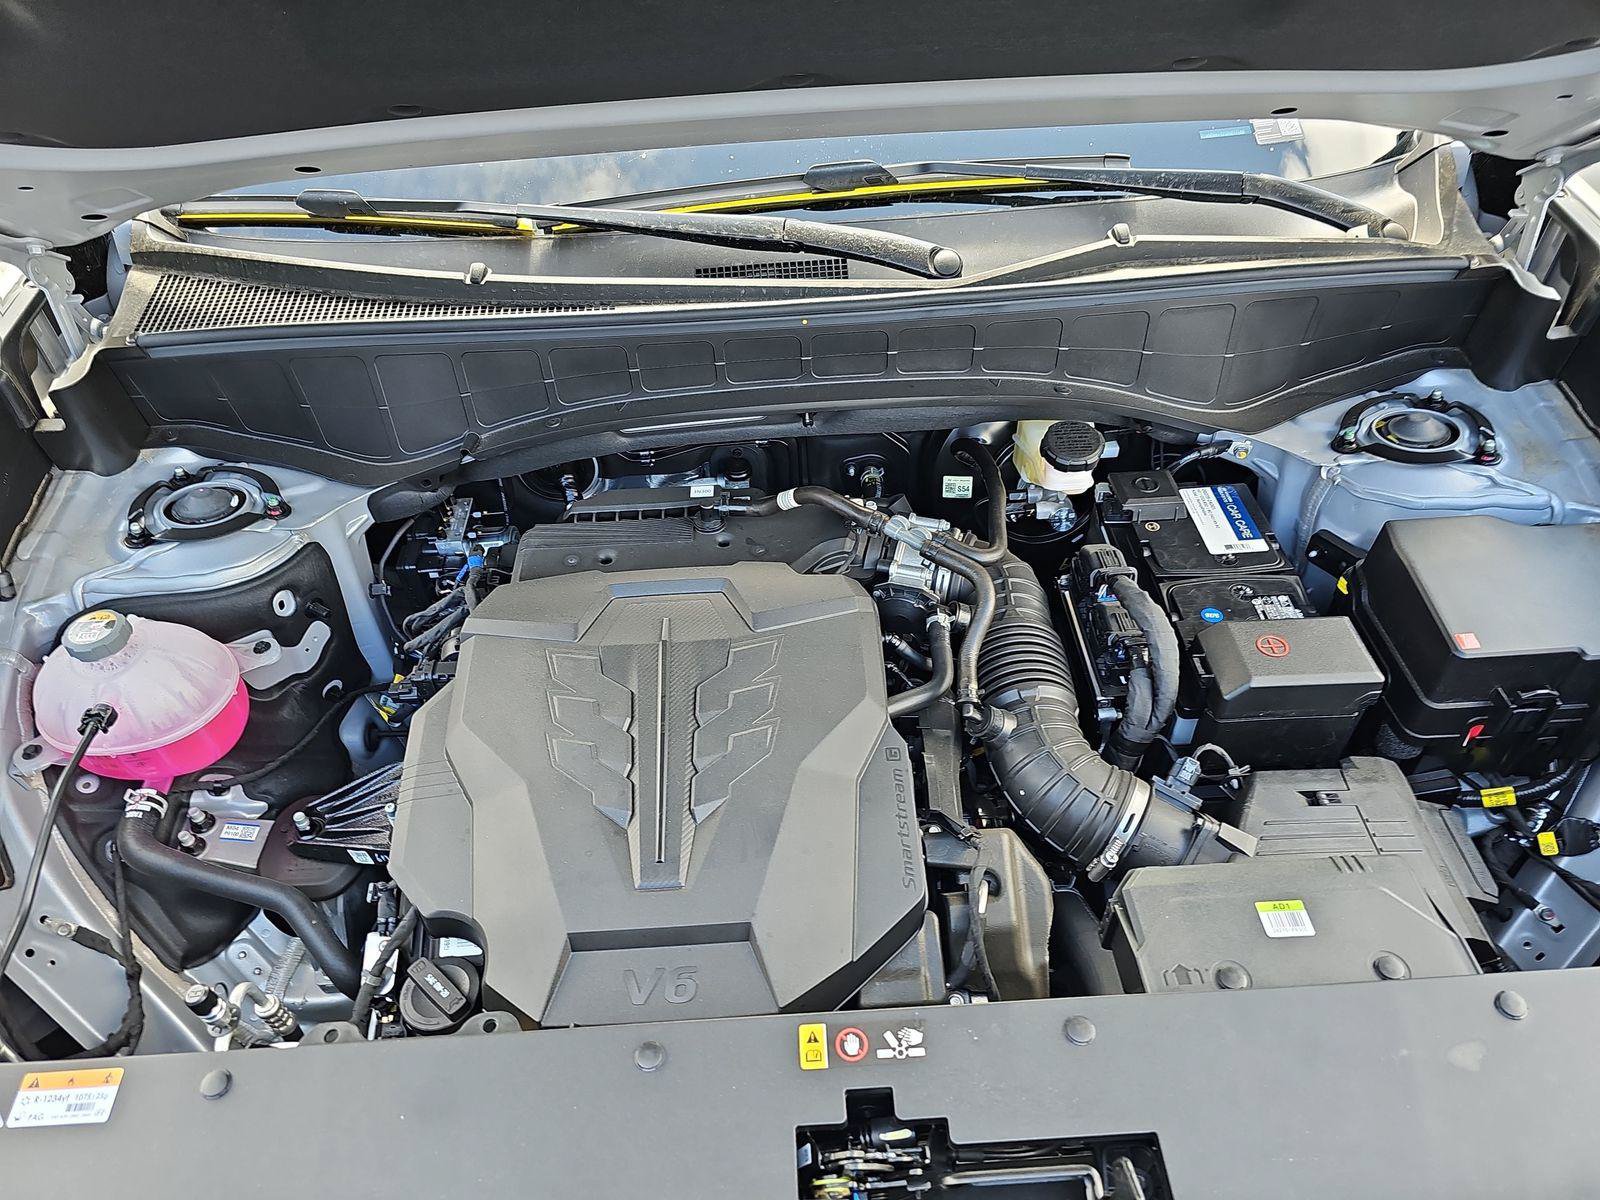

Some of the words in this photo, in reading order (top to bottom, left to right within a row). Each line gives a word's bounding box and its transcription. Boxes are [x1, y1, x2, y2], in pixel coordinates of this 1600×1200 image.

[957, 485, 970, 493] S54
[1226, 504, 1242, 519] CAR
[1235, 519, 1254, 539] CARE
[891, 768, 918, 891] Smartstream
[623, 965, 698, 1006] V6
